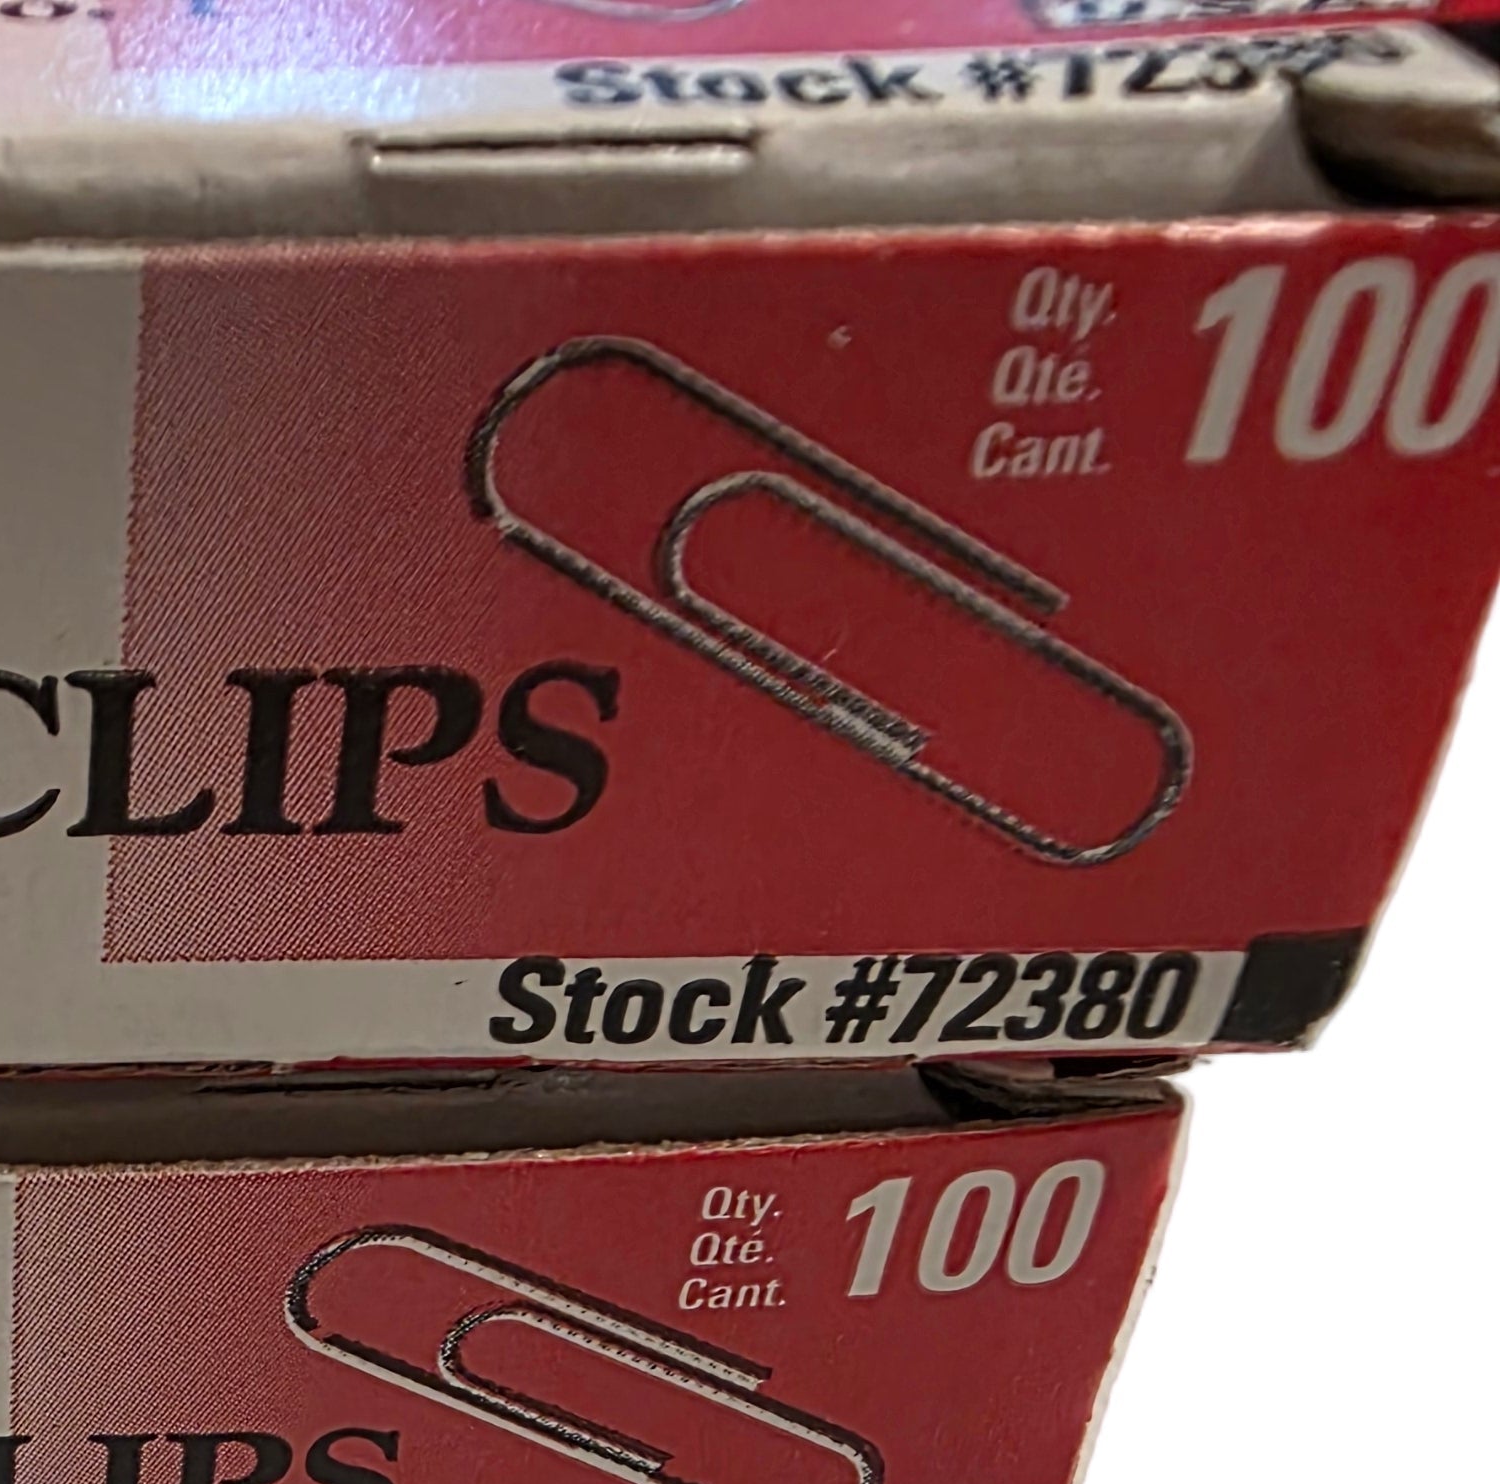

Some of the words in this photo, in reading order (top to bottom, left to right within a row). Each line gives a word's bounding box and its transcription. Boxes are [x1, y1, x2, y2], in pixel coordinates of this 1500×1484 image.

[553, 54, 942, 104] Stock
[1009, 265, 1118, 342] Qty.
[1185, 253, 1500, 464] 100
[489, 954, 806, 1047] Stock
[825, 950, 1202, 1046] #72380
[700, 1186, 783, 1221] Qty.
[845, 1158, 1106, 1298] 100
[689, 1228, 775, 1267] Qté.
[678, 1277, 787, 1311] Cant.
